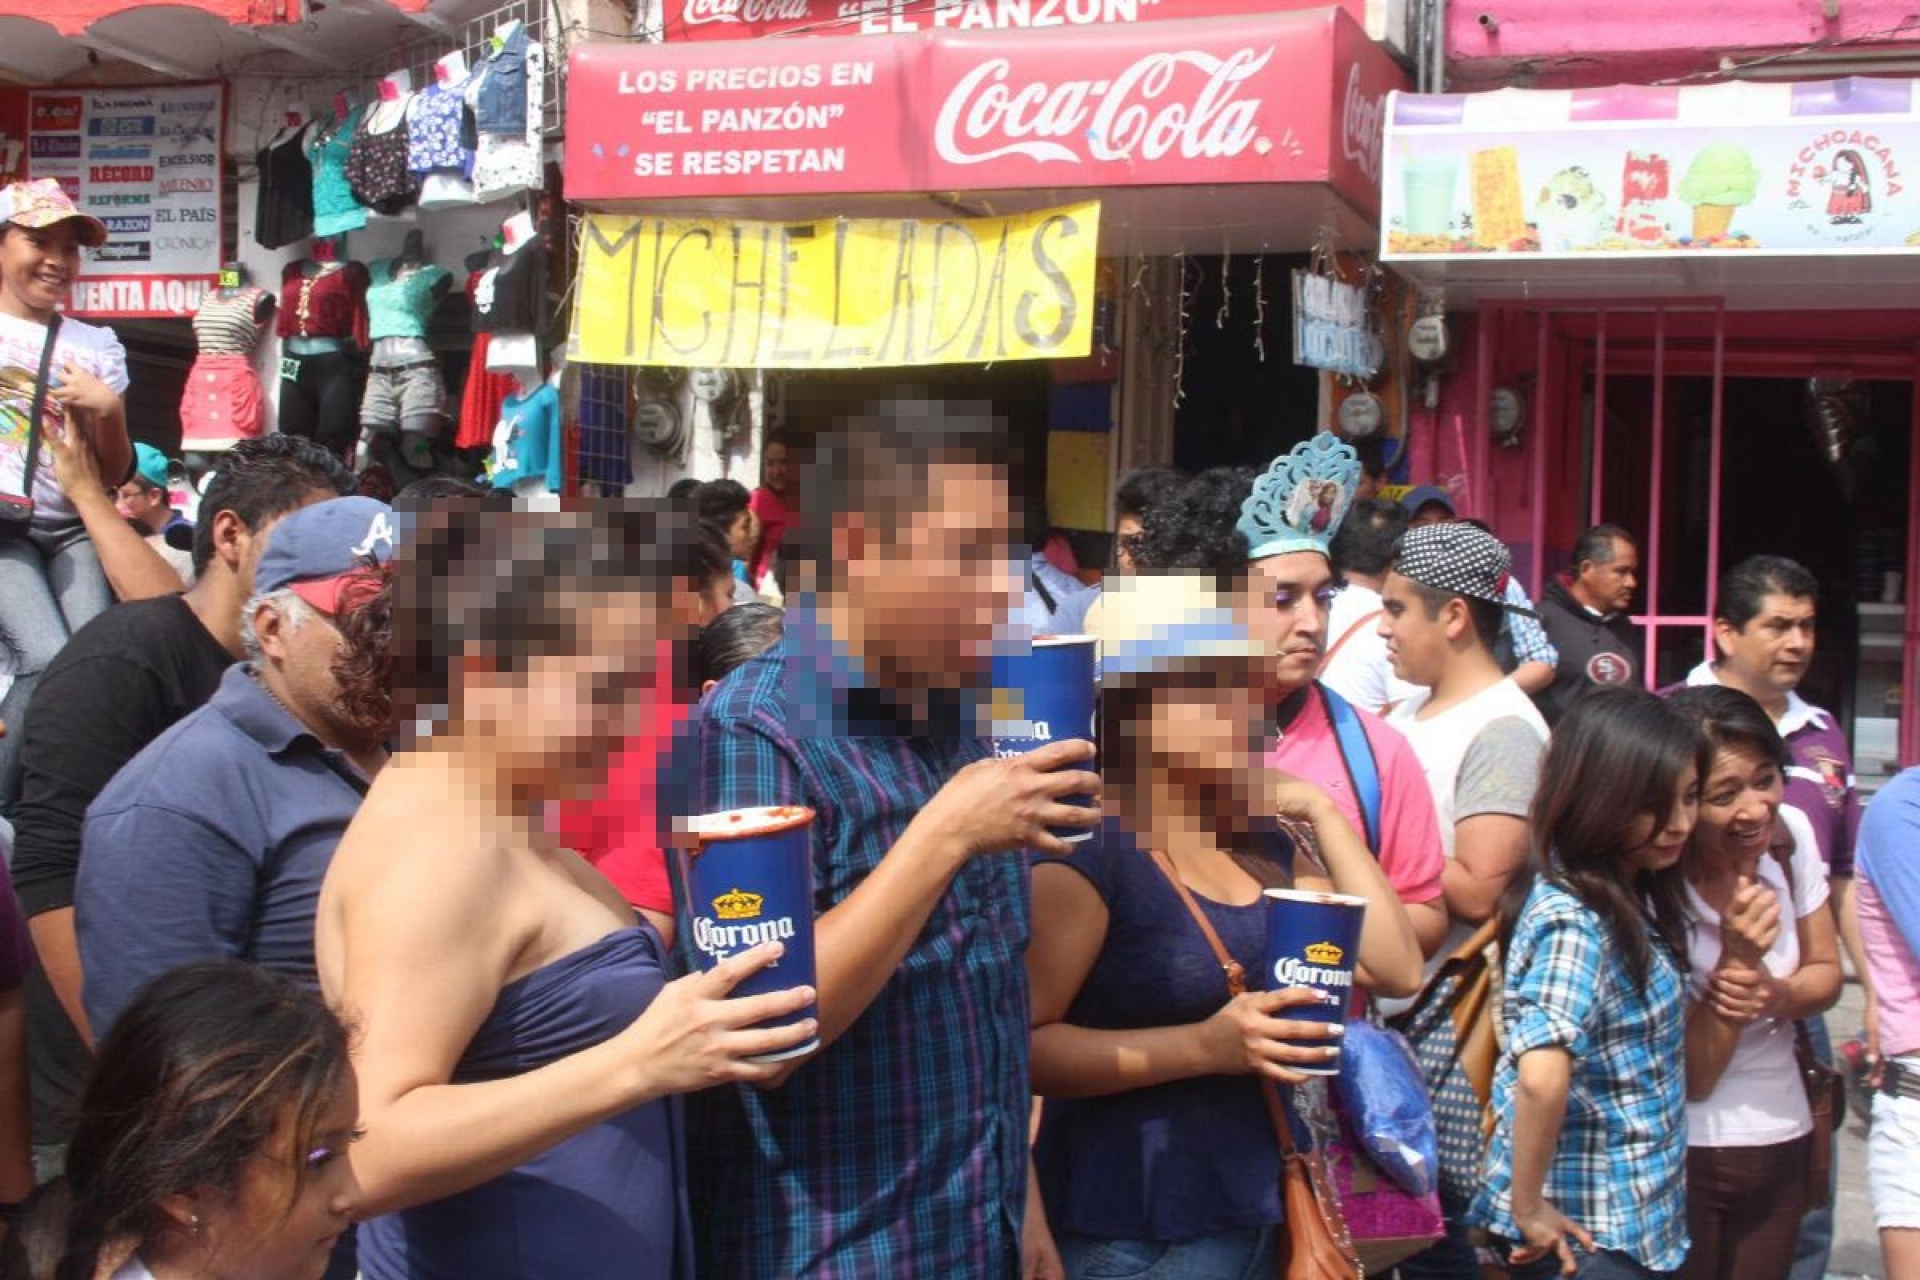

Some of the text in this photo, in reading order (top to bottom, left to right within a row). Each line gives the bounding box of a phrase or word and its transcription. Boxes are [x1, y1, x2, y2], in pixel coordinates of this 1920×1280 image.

[618, 62, 874, 94] LOS PRECIOS EN
[642, 101, 844, 134] “EL PANZÓN”
[935, 45, 1275, 165] Coca-Cola
[634, 147, 845, 176] SE RESPETAN
[1786, 129, 1904, 197] MICHOACANA
[156, 209, 177, 222] EL
[70, 280, 145, 311] VENTA
[566, 213, 1079, 362] MICHELADAS
[692, 916, 795, 956] Corona
